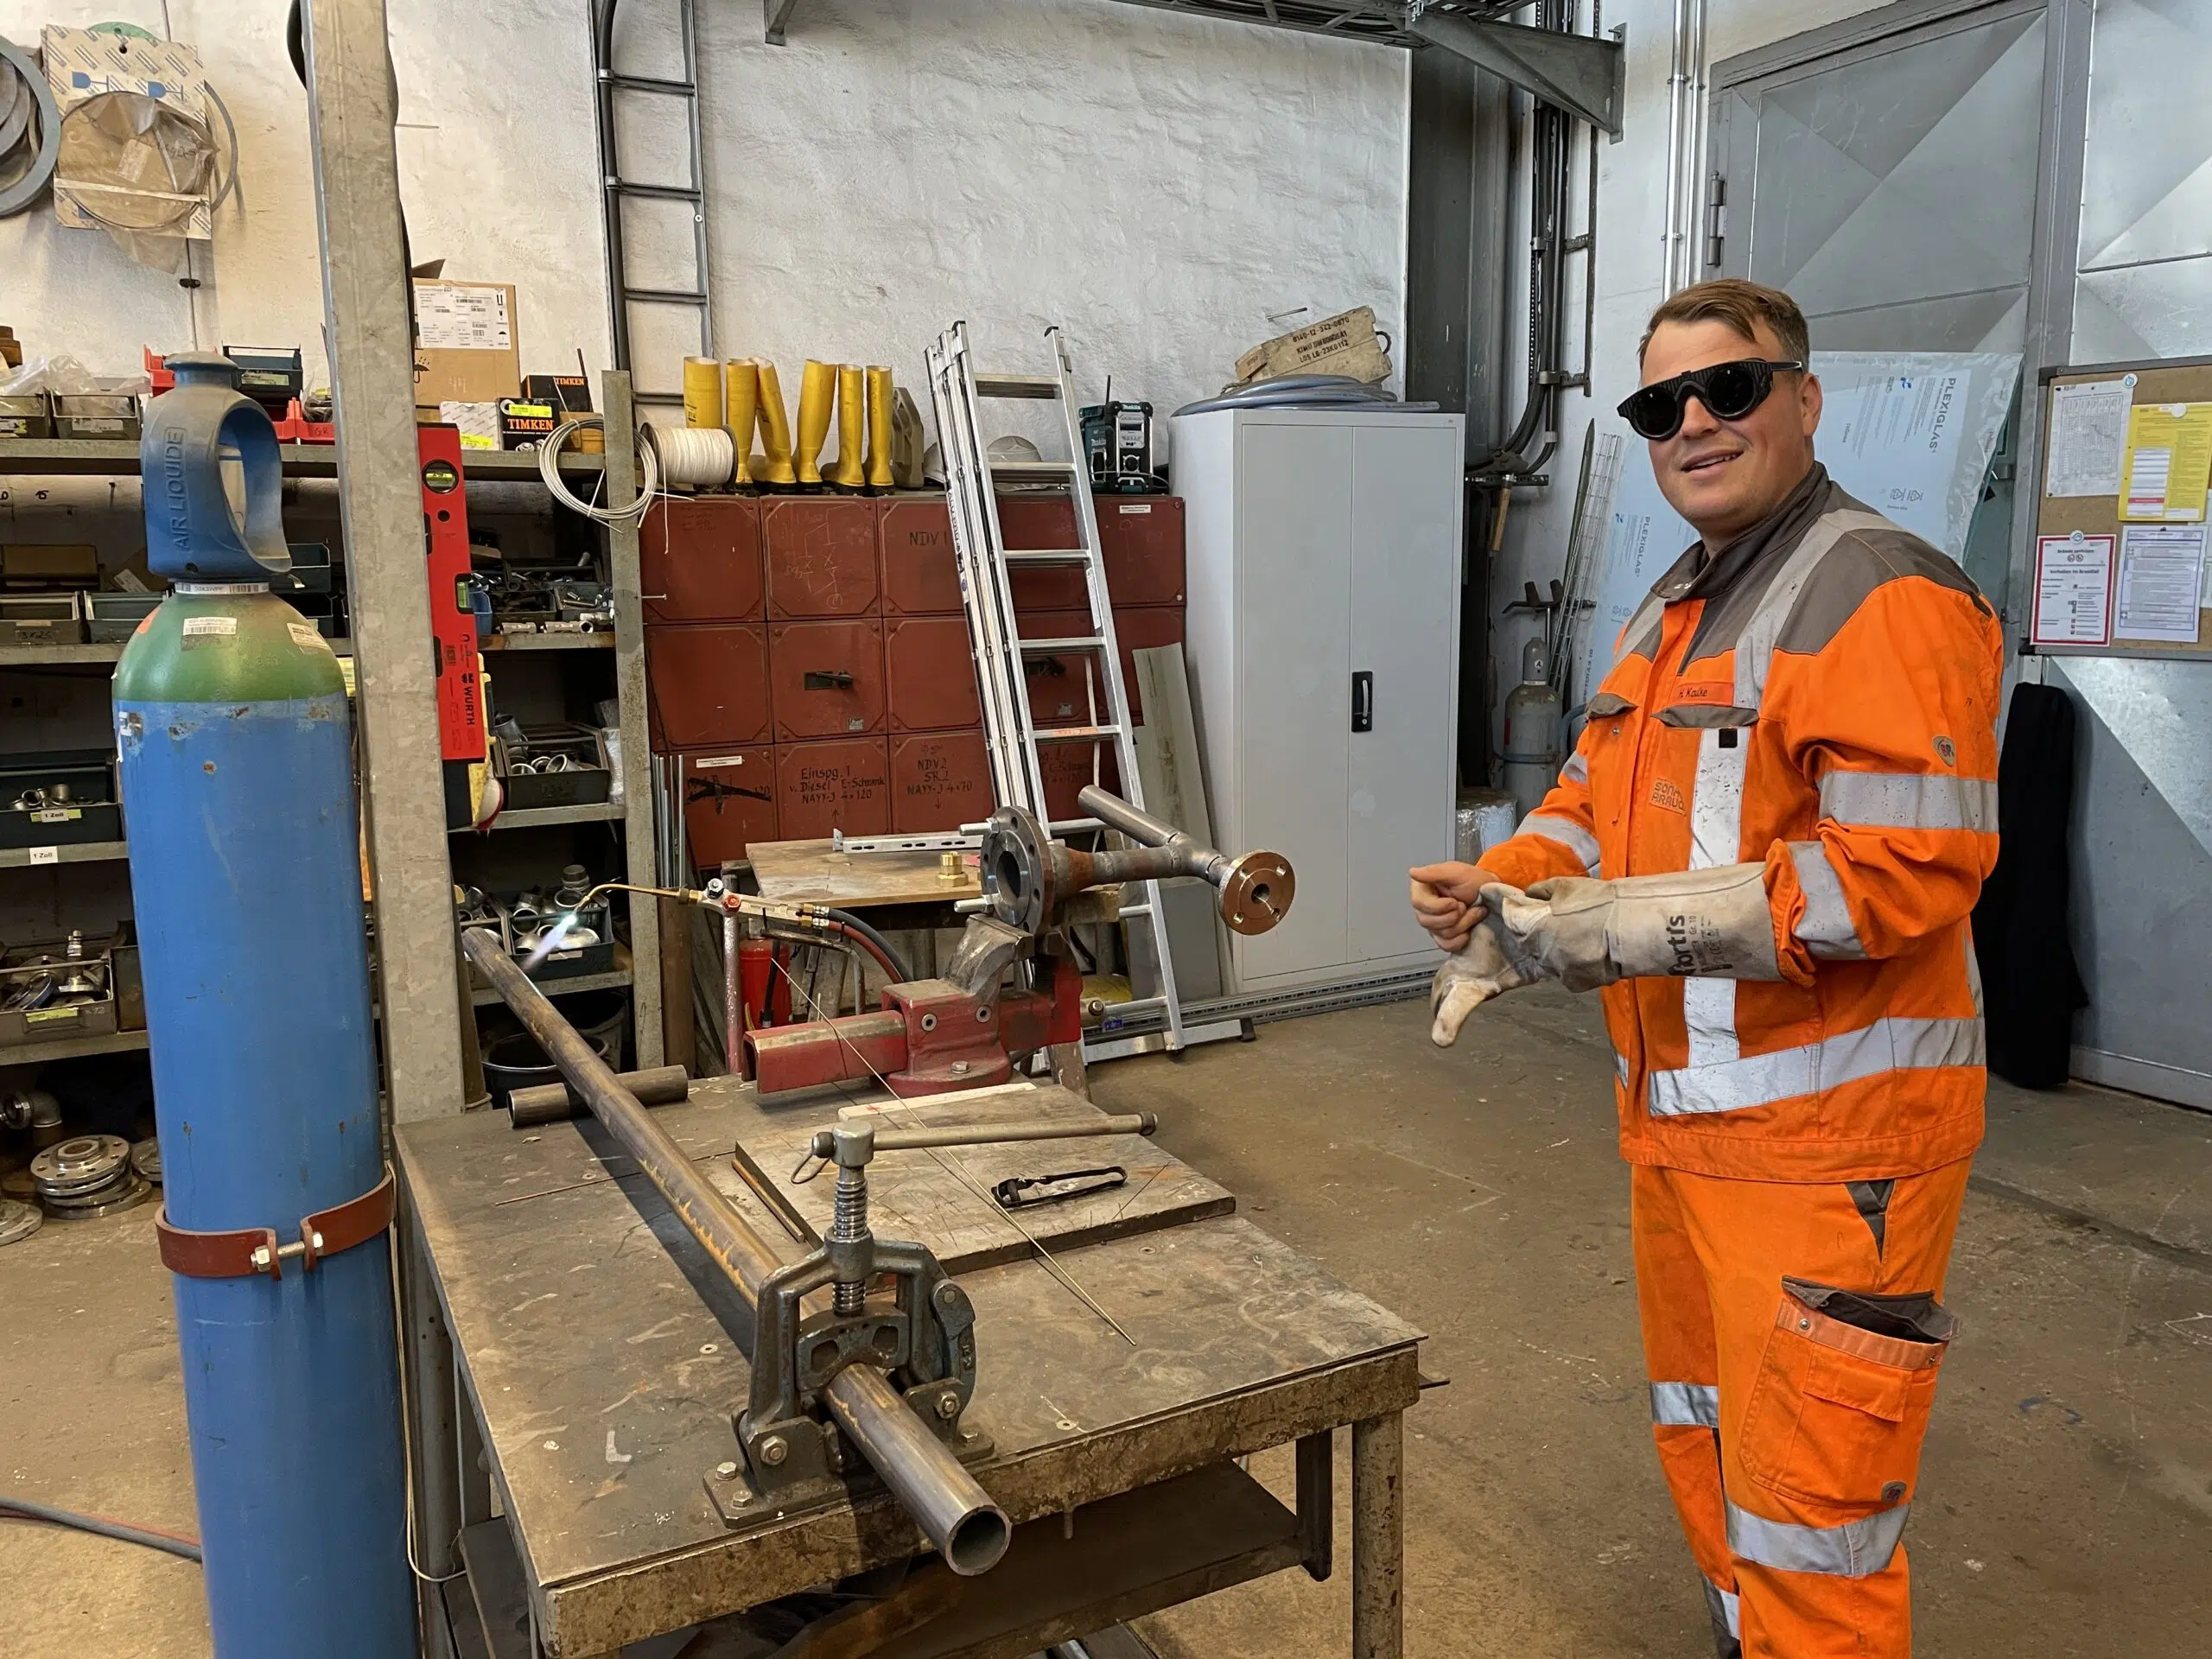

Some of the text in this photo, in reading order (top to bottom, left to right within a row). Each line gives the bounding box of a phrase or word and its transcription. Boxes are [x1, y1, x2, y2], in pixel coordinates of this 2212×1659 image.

[555, 378, 584, 386] TIMKEN
[507, 418, 554, 431] TIMKEN
[165, 431, 192, 553] AIR LIQUIDE
[799, 779, 831, 792] Diesel
